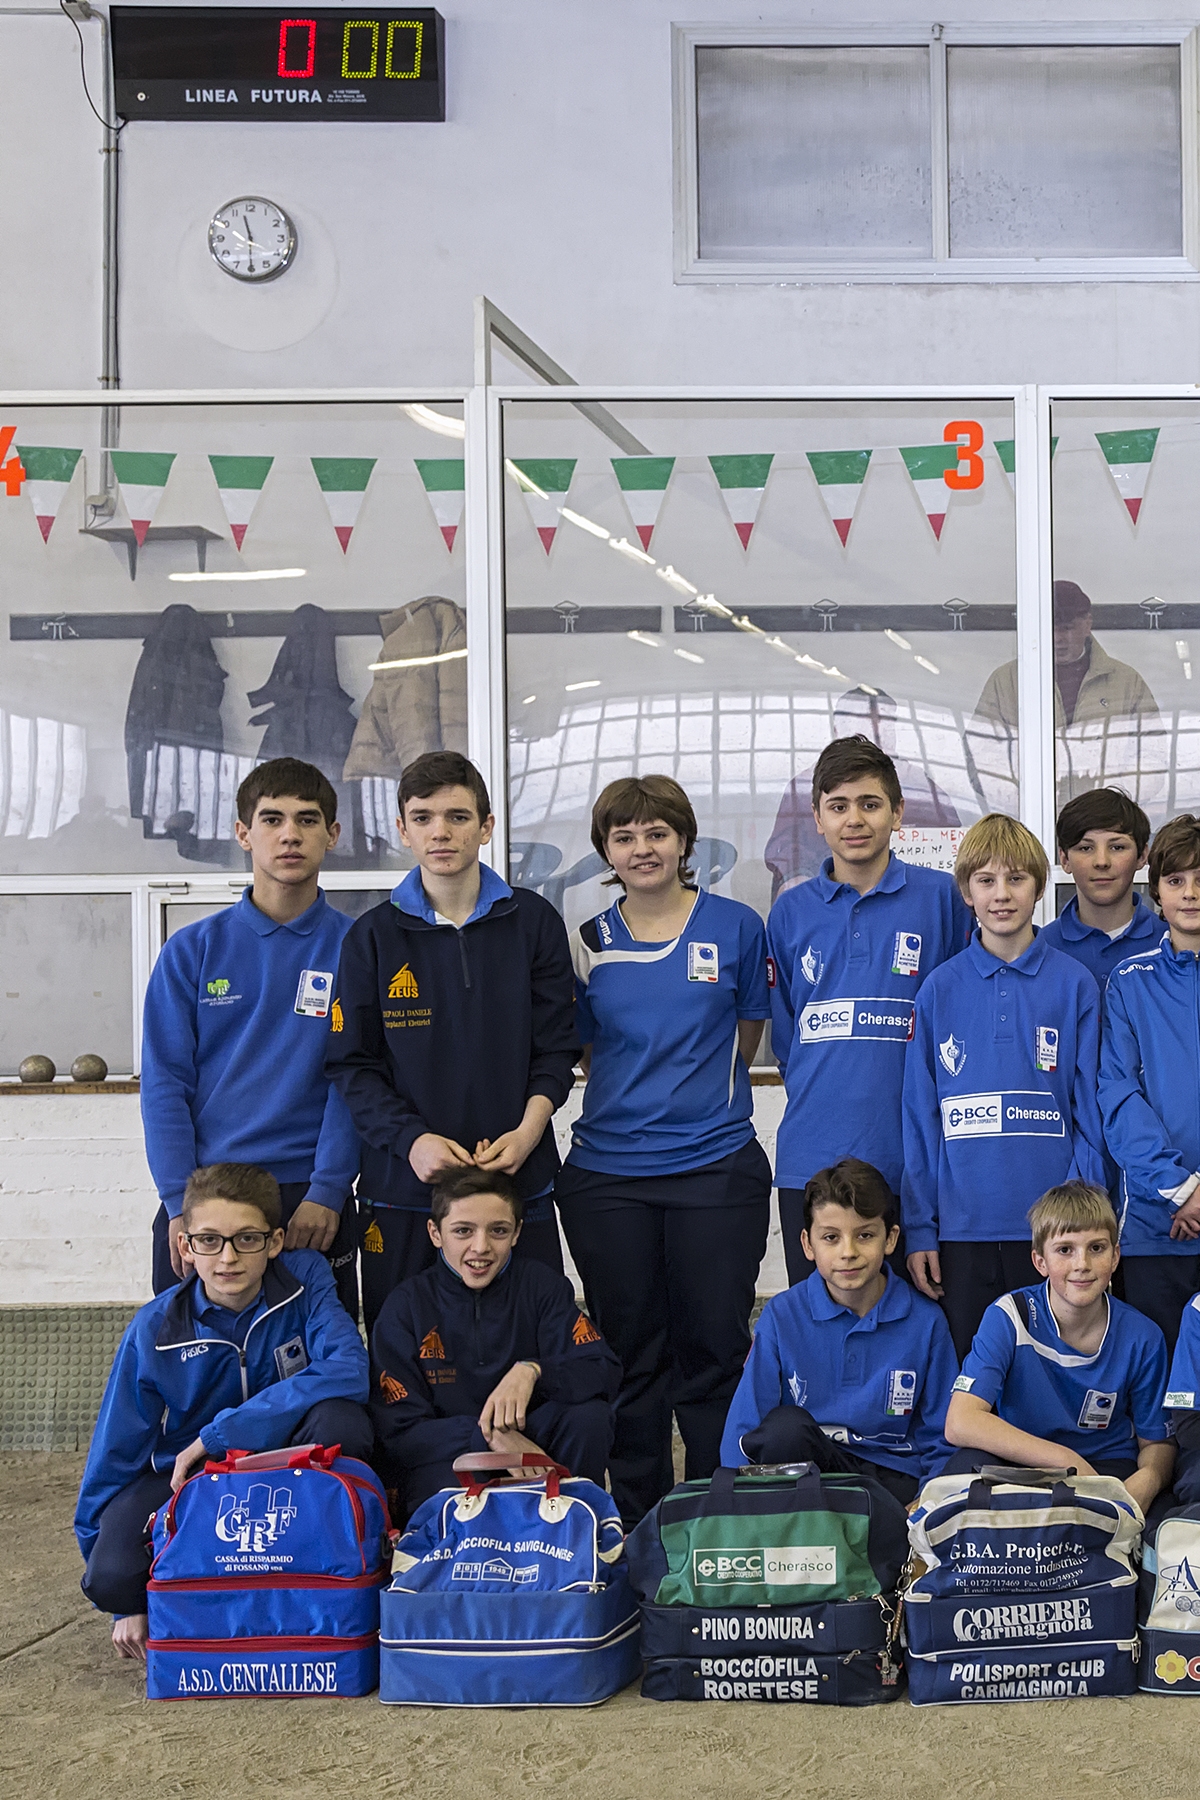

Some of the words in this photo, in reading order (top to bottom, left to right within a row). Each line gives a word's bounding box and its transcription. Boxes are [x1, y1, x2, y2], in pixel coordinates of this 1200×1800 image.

[278, 19, 317, 78] 0
[185, 89, 239, 103] LINEA
[250, 89, 323, 103] FUTURA
[0, 427, 26, 496] 4
[943, 421, 984, 490] 3
[388, 987, 419, 998] ZEUS
[821, 1011, 849, 1023] BCC
[964, 1106, 998, 1119] BCC
[1006, 1106, 1061, 1121] Cherasco
[575, 1332, 602, 1346] ZEUS
[419, 1348, 446, 1359] ZEUS
[240, 1555, 248, 1563] di
[249, 1555, 293, 1563] RISPARMIO
[422, 1548, 453, 1564] A.S.D.
[950, 1543, 1000, 1560] G.B.A.
[1006, 1542, 1062, 1562] Project
[225, 1564, 232, 1572] di
[233, 1564, 269, 1572] FOSSANO
[717, 1556, 761, 1571] BCC
[767, 1561, 833, 1572] Cherasco
[951, 1562, 1031, 1575] Automazione
[1035, 1555, 1089, 1575] industriale
[717, 1571, 734, 1579] CREDITO
[955, 1578, 968, 1587] Tel.
[970, 1578, 1020, 1587] 0172/717469
[1024, 1579, 1038, 1587] Fax
[953, 1598, 1091, 1641] CORRIERE
[702, 1617, 740, 1640] PINO
[745, 1617, 814, 1640] BONURA
[965, 1615, 1094, 1641] Carmagnola
[701, 1657, 819, 1677] BOCCIOFILA
[950, 1662, 1053, 1683] POLISPORT
[1057, 1659, 1106, 1678] CLUB
[178, 1667, 218, 1692] A.S.D.
[219, 1661, 338, 1692] CENTALLESE
[704, 1680, 819, 1699] RORETESE
[961, 1680, 1089, 1699] CARMAGNOLA
